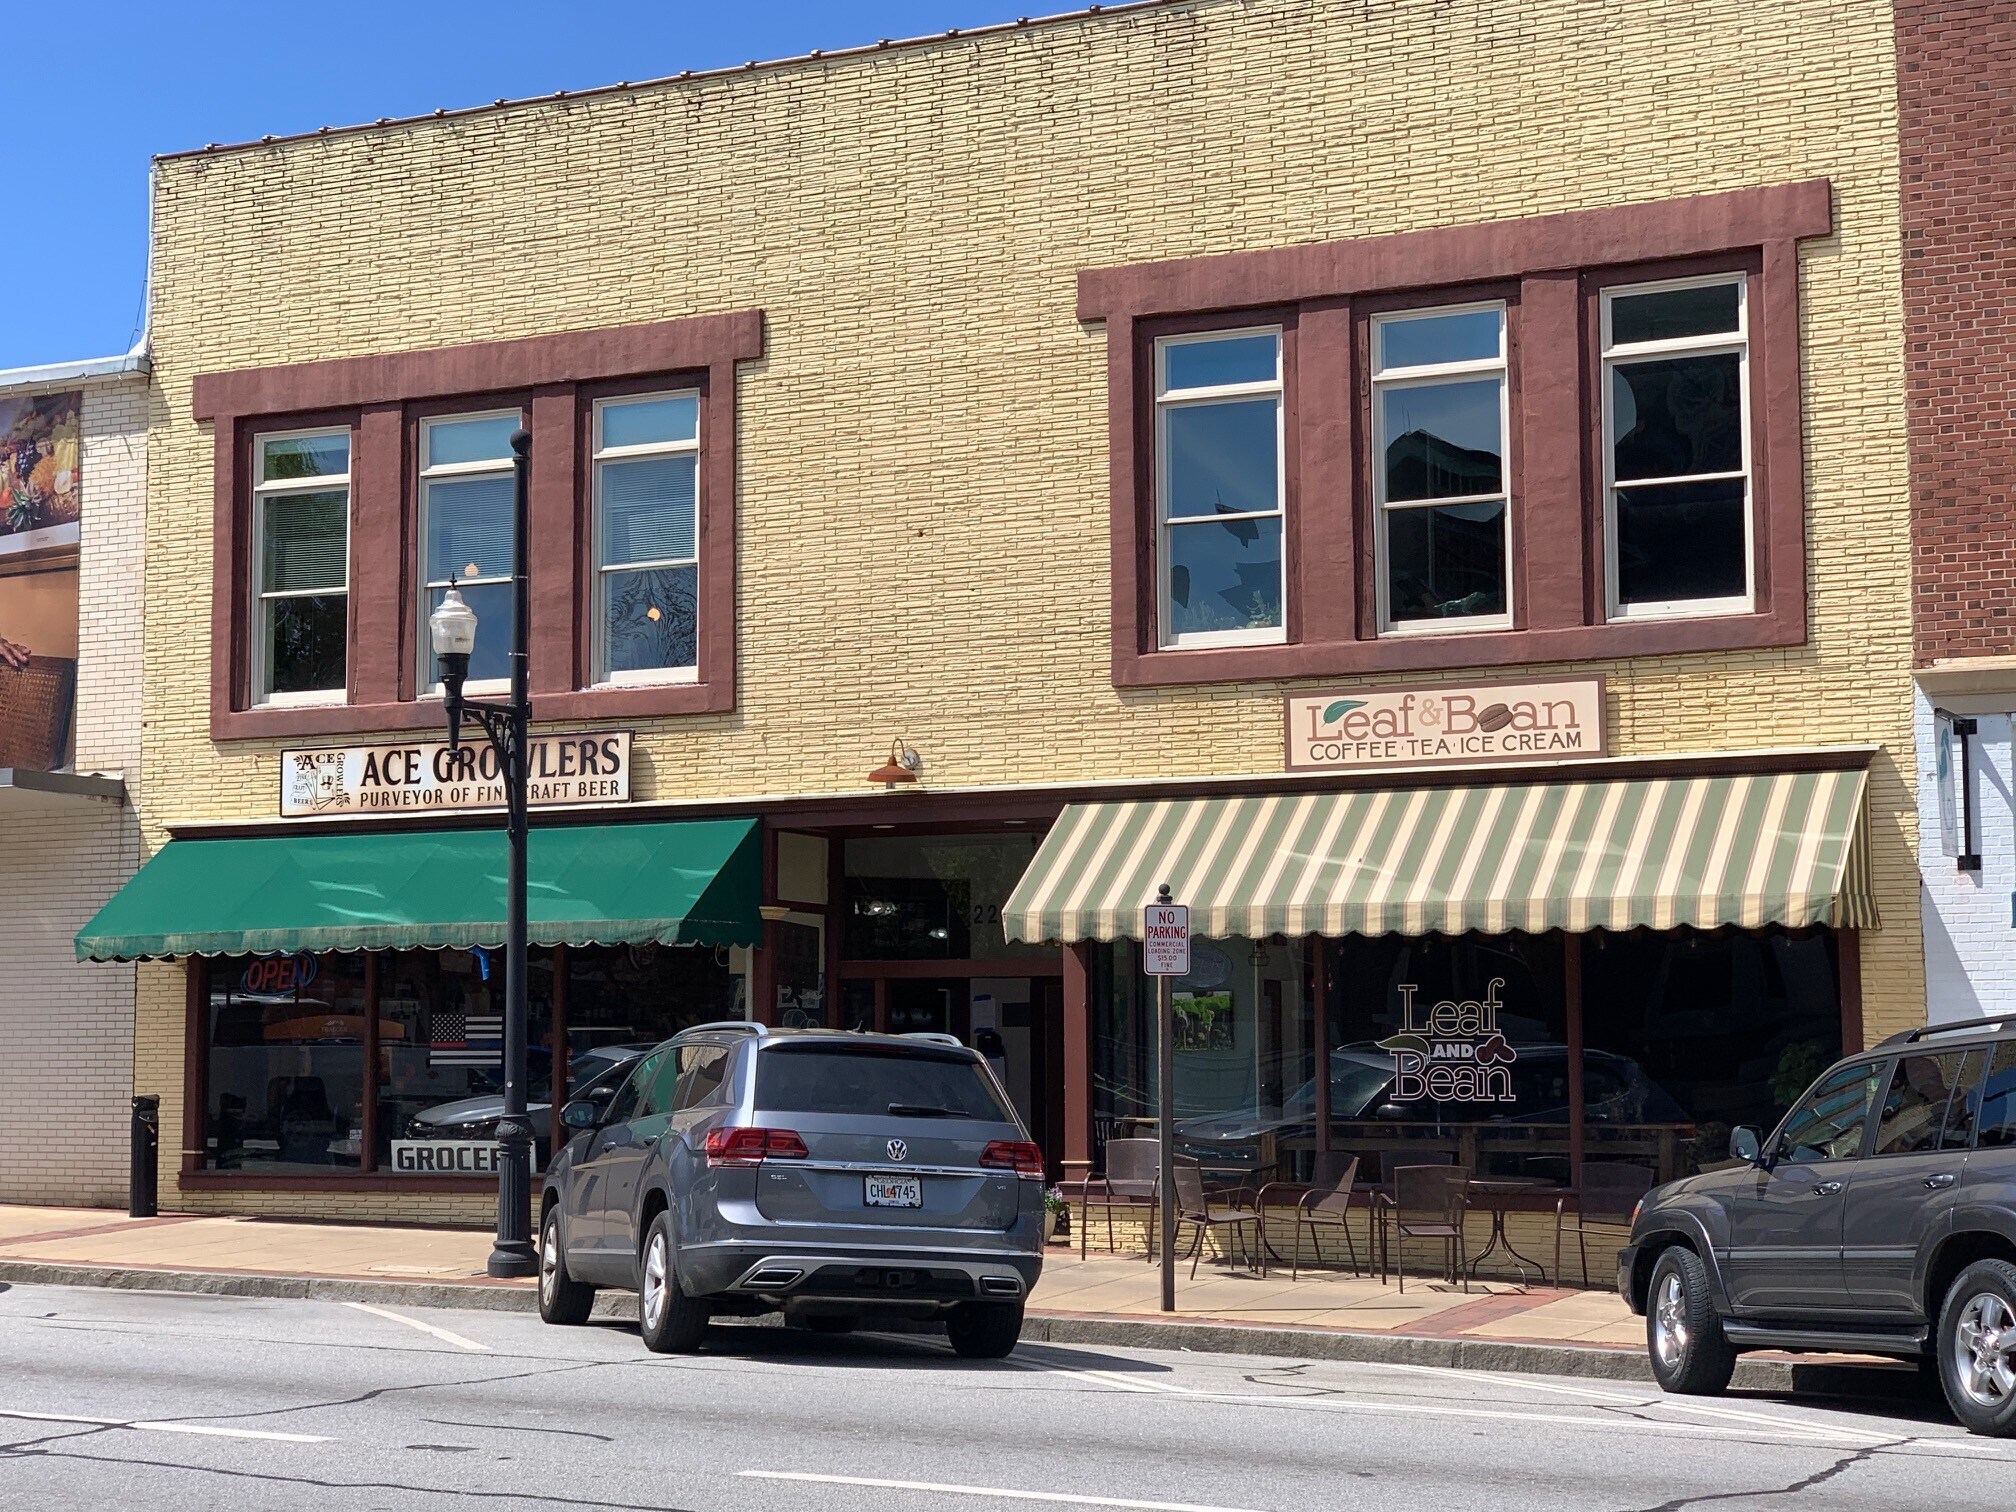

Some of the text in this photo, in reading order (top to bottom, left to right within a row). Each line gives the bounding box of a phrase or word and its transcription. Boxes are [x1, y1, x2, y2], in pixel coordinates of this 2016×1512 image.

[1306, 694, 1415, 741] Leaf
[1310, 731, 1582, 761] COFFEE TEA ICE CREAM
[299, 753, 335, 771] ACE
[360, 738, 621, 787] ACE GROLERS
[360, 780, 620, 807] PURVEYOR OF FIN RAFT BEER
[1158, 911, 1175, 924] NO
[1148, 926, 1186, 939] PARKING
[247, 958, 308, 990] OPEN
[1398, 977, 1505, 1036] Leaf
[1432, 1043, 1474, 1058] AND
[1389, 1049, 1516, 1102] Bean
[397, 1146, 502, 1172] GROCER
